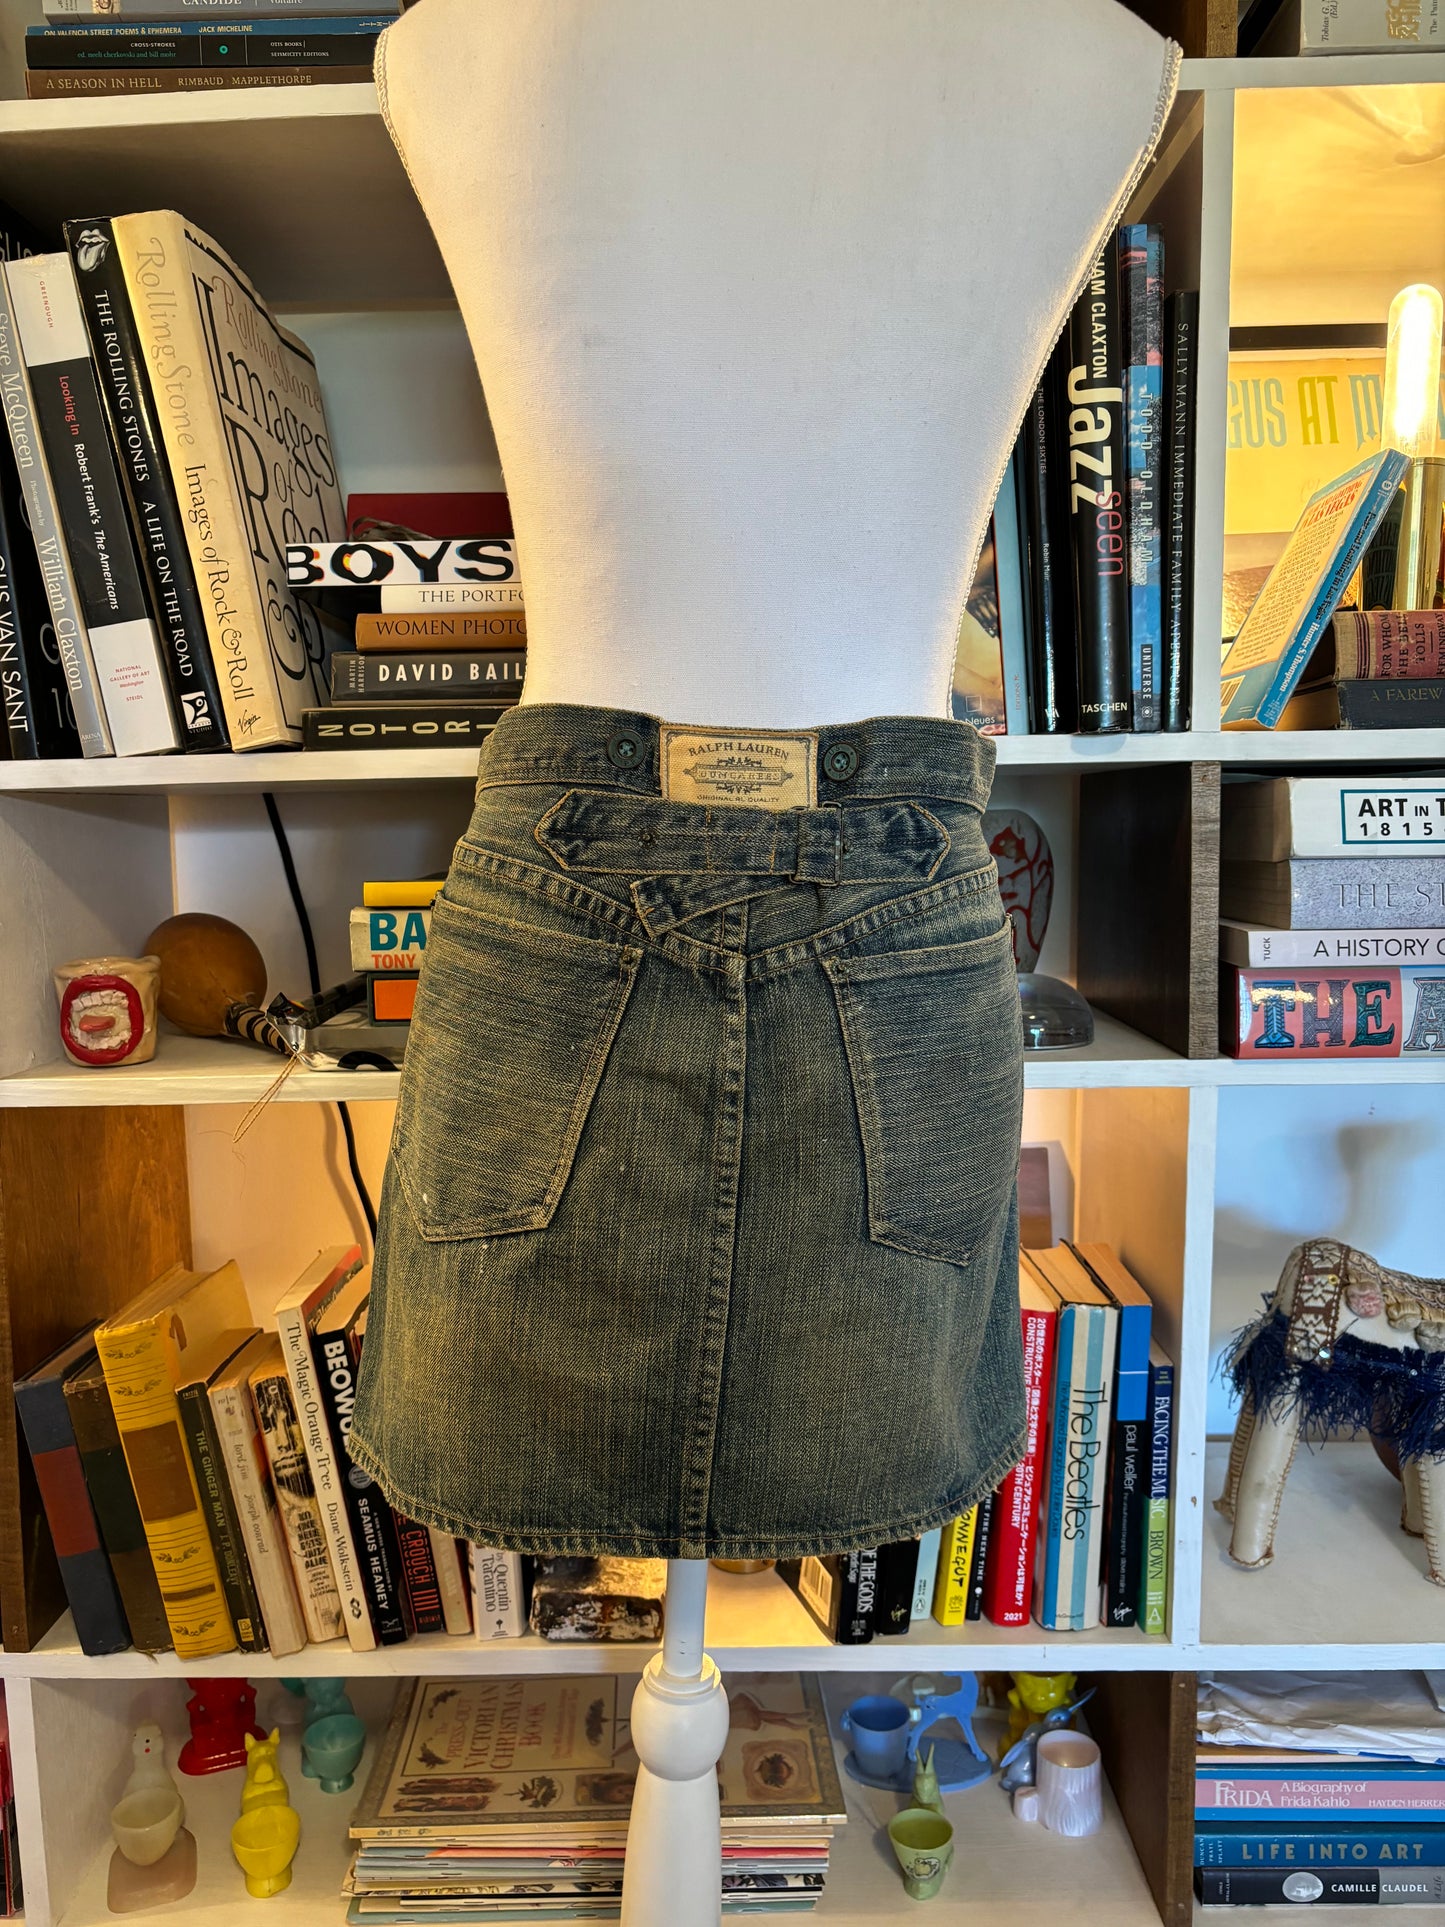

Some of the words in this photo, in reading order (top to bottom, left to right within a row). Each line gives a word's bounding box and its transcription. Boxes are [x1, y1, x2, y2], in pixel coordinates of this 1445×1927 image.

[141, 27, 146, 35] &
[148, 27, 182, 35] EPHEMERA
[46, 80, 54, 88] A
[58, 79, 106, 89] SEASON
[111, 78, 125, 88] IN
[129, 78, 162, 88] HELL
[178, 77, 224, 86] RIMBAUD
[231, 75, 312, 85] MAPPLETHORPE
[39, 280, 54, 328] GREENOUGH
[94, 290, 113, 326] THE
[1091, 302, 1107, 379] CLAXTON
[1177, 323, 1188, 376] SALLY
[104, 332, 133, 411] ROLLING
[1, 371, 34, 469] McQueen
[59, 375, 77, 422] Looking
[69, 422, 80, 436] In
[1038, 405, 1046, 442] LONDON
[1175, 384, 1187, 437] MANN
[1297, 375, 1339, 446] AT
[123, 414, 150, 482] STONES
[1068, 364, 1122, 514] Jazz
[74, 443, 92, 484] Robert
[83, 484, 101, 526] Frank's
[142, 501, 157, 514] A
[185, 464, 212, 540] Images
[1172, 441, 1186, 543] IMMEDIATE
[146, 518, 164, 553] LIFE
[1095, 491, 1124, 577] seen
[1139, 470, 1153, 562] OLDHAM
[94, 529, 107, 551] The
[200, 546, 226, 568] of
[97, 551, 119, 611] Americans
[157, 558, 173, 584] ON
[286, 539, 515, 585] BOYS
[1170, 550, 1183, 613] FAMILY
[39, 535, 67, 613] William
[57, 616, 83, 692] Claxton
[162, 588, 181, 625] THE
[207, 570, 237, 627] Rock
[418, 589, 455, 603] THE
[0, 610, 18, 663] VAN
[376, 619, 454, 636] WOMEN
[1302, 622, 1320, 650] Hunter
[1379, 614, 1392, 651] WHOM
[1415, 623, 1425, 665] TOLLS
[115, 665, 141, 673] NATIONAL
[172, 629, 194, 678] ROAD
[379, 664, 453, 682] DAVID
[1142, 647, 1151, 699] UNIVERSE
[1279, 653, 1304, 692] Thompson
[1381, 654, 1392, 677] FOR
[1397, 649, 1409, 677] THE
[227, 653, 255, 701] Roll
[1371, 689, 1380, 701] A
[1386, 687, 1442, 701] FAREW
[2, 670, 29, 732] SANT
[1081, 702, 1128, 714] TASCHEN
[688, 742, 733, 757] RALPH
[738, 742, 789, 761] LAUREN
[1358, 798, 1408, 817] ART
[1414, 806, 1429, 817] IN
[1332, 883, 1399, 908] THE
[372, 953, 416, 969] TONY
[1263, 937, 1271, 961] TUCK
[1313, 940, 1329, 957] A
[1337, 938, 1430, 957] HISTORY
[1252, 978, 1395, 1049] THE
[287, 1323, 302, 1351] The
[1024, 1317, 1036, 1387] CONSTRUCTIVE
[294, 1350, 312, 1402] Magic
[304, 1401, 323, 1454] Orange
[1070, 1381, 1107, 1435] The
[1153, 1396, 1170, 1445] FACING
[1124, 1424, 1137, 1452] paul
[195, 1430, 204, 1453] THE
[201, 1456, 219, 1499] GINGER
[212, 1501, 226, 1529] MAN
[316, 1452, 332, 1490] Tree
[1015, 1462, 1025, 1486] 20TH
[1122, 1453, 1137, 1492] weller
[1152, 1446, 1168, 1476] THE
[234, 1443, 244, 1468] lord
[243, 1491, 259, 1524] joseph
[252, 1523, 269, 1554] conrad
[1011, 1486, 1023, 1528] CENTURY
[1064, 1441, 1101, 1540] Beatles
[1151, 1478, 1166, 1519] MUSIC
[326, 1502, 340, 1534] Diane
[333, 1534, 354, 1592] Wolkstein
[358, 1498, 377, 1552] SEAMUS
[369, 1555, 389, 1610] HEANEY
[405, 1530, 431, 1585] CROUCH
[980, 1537, 989, 1558] NEXT
[1149, 1530, 1164, 1580] BROWN
[482, 1554, 497, 1613] Tarantino
[494, 1564, 511, 1612] Quentin
[860, 1560, 877, 1581] THE
[977, 1560, 985, 1581] TIME
[857, 1581, 875, 1613] GODS
[1004, 1612, 1023, 1621] 2021
[464, 1684, 499, 1769] VICTORIAN
[490, 1681, 525, 1770] CHRISTMAS
[519, 1702, 546, 1747] BOOK
[1214, 1780, 1274, 1807] FRIDA
[1280, 1782, 1290, 1792] A
[1291, 1781, 1352, 1795] Biography
[1354, 1781, 1368, 1792] of
[1280, 1796, 1311, 1807] Frida
[1313, 1796, 1350, 1807] Kahlo
[1369, 1799, 1406, 1808] HAYDEN
[1242, 1843, 1295, 1860] LIFE
[1309, 1843, 1368, 1860] INTO
[1379, 1843, 1424, 1860] ART
[1331, 1884, 1377, 1893] CAMILLE
[1382, 1883, 1429, 1892] CLAUDEL
